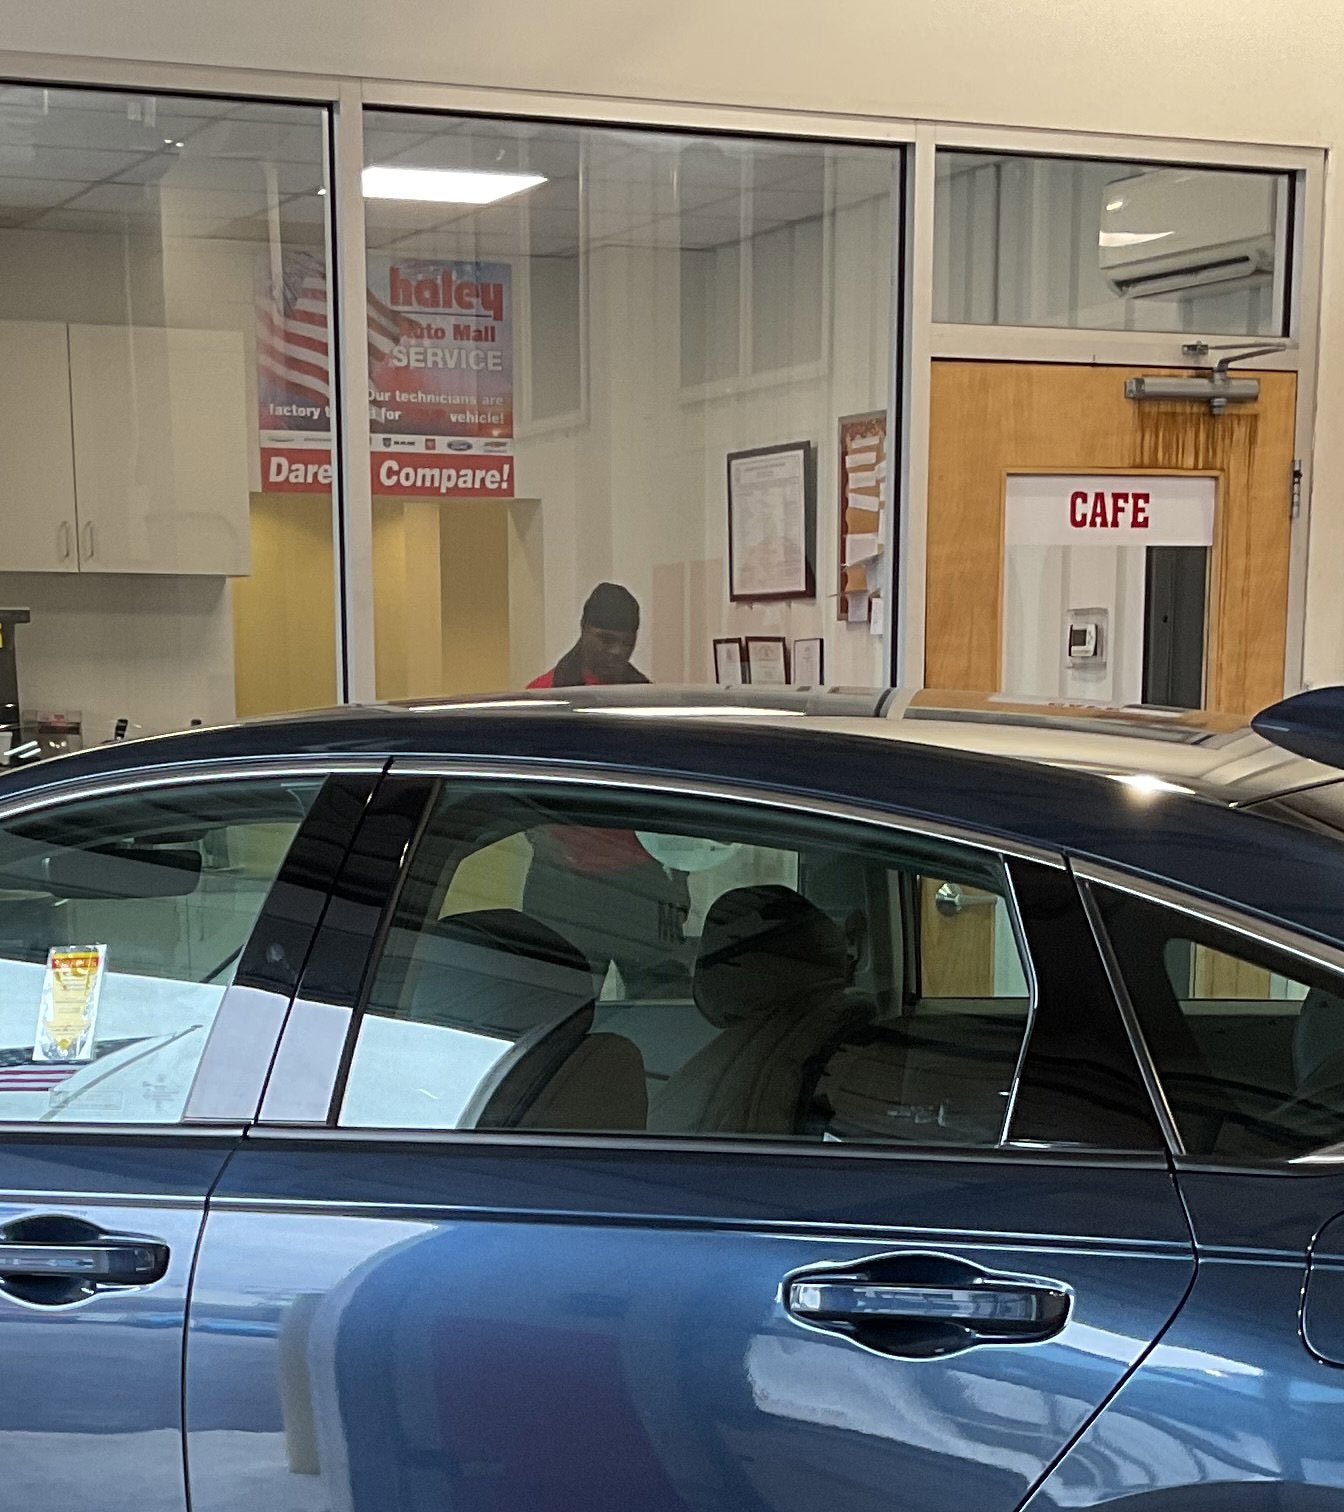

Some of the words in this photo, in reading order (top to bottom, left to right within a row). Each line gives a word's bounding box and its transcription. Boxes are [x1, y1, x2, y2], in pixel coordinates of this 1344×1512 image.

[389, 266, 503, 321] haley
[453, 324, 496, 342] Mall
[391, 347, 504, 371] SERVICE
[395, 390, 478, 405] technicians
[481, 396, 504, 406] are
[269, 403, 320, 421] factory
[381, 408, 402, 421] for
[449, 411, 505, 425] vehicle!
[269, 456, 333, 484] Dare
[379, 459, 510, 494] Compare!
[1070, 491, 1150, 528] CAFE
